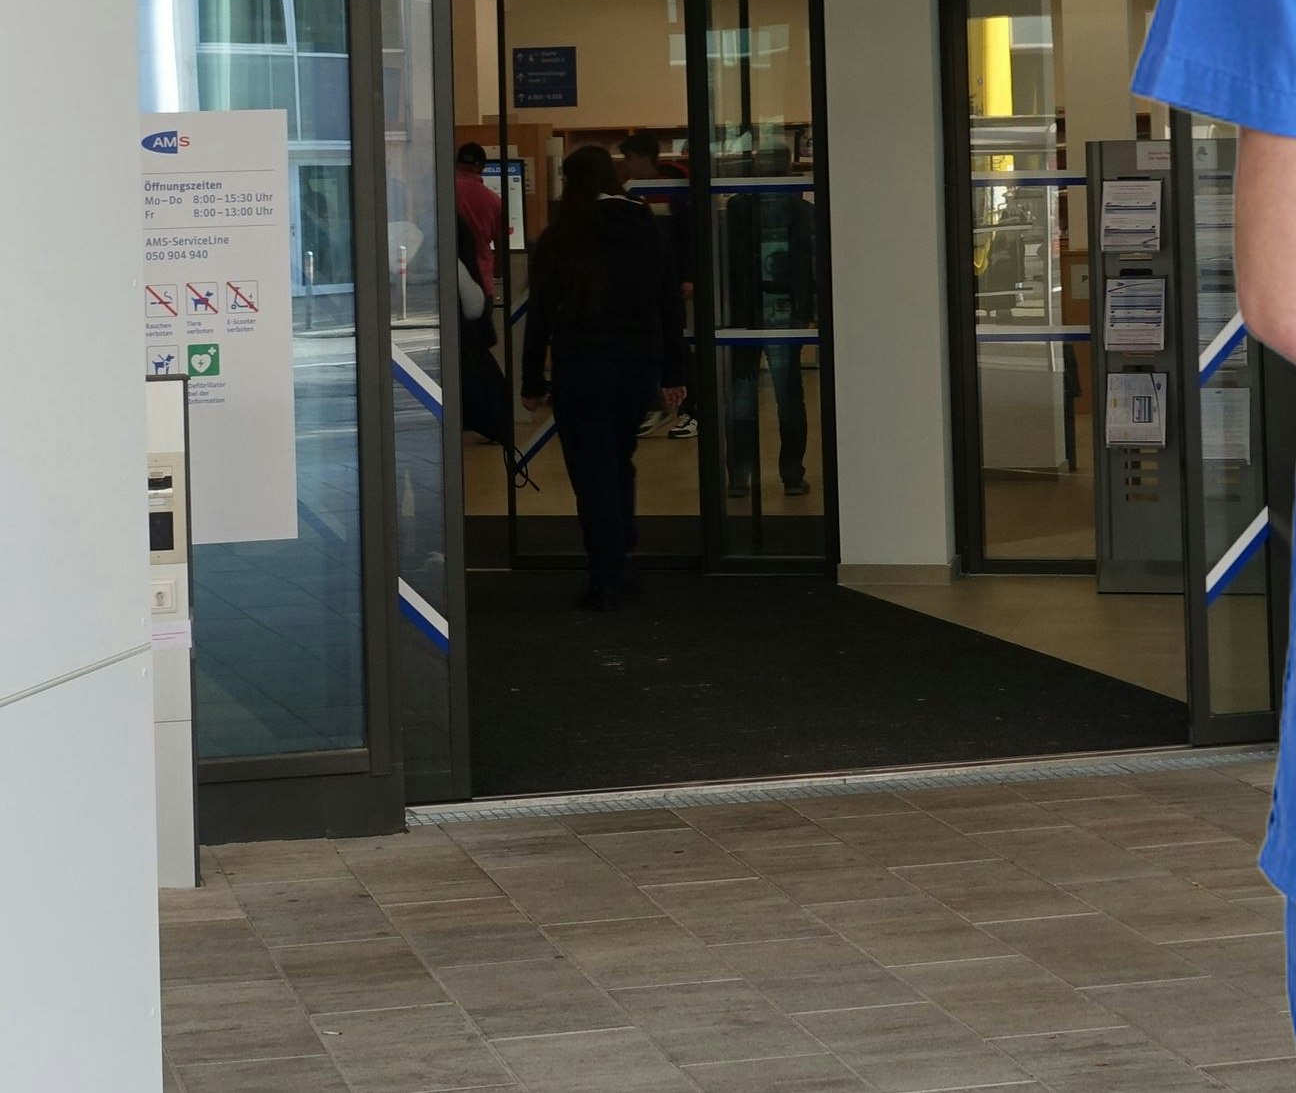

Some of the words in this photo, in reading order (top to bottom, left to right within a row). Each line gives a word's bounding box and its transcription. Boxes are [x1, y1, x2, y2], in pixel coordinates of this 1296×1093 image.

[152, 136, 191, 147] AMS
[144, 180, 223, 192] Öffnungszeiten
[255, 193, 273, 202] Uhr
[145, 210, 155, 219] Fr
[256, 207, 274, 216] Uhr
[145, 235, 230, 247] AMS-ServiceLine
[145, 251, 165, 261] 050
[167, 250, 187, 260] 904
[189, 249, 208, 259] 940
